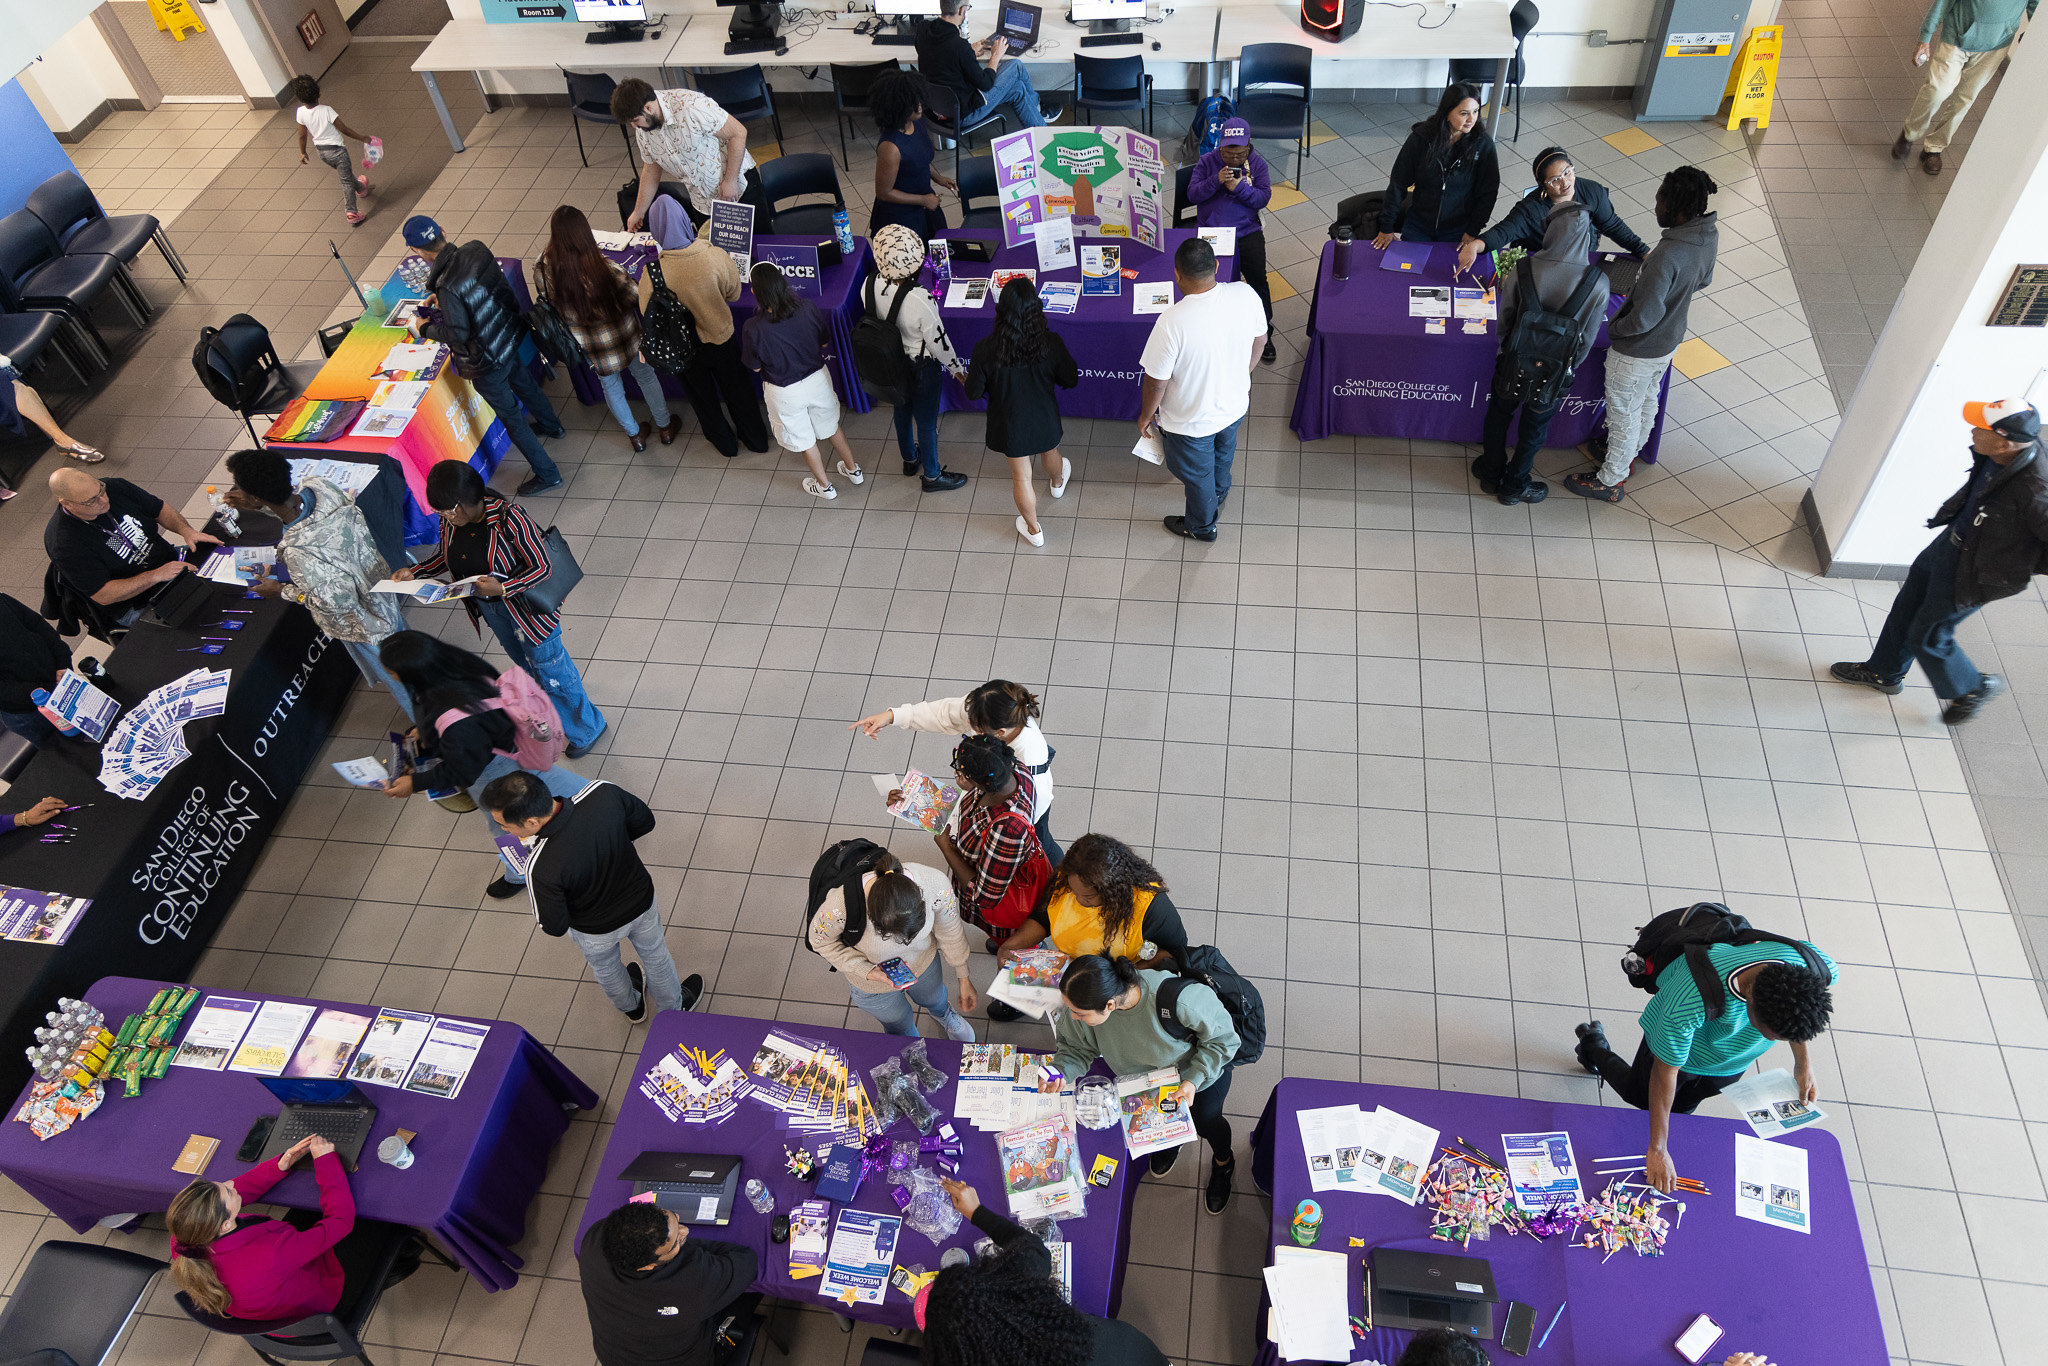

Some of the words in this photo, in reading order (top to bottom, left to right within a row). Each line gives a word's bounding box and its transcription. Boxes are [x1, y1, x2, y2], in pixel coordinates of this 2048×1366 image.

[542, 8, 555, 16] 123
[302, 12, 323, 46] EXIT
[1753, 52, 1774, 61] CAUTION
[1224, 128, 1245, 137] SDCCE
[734, 225, 749, 233] REACH
[1101, 226, 1127, 237] Community
[729, 232, 743, 240] GOAL!
[777, 265, 815, 278] DCCE
[1077, 369, 1134, 380] ORWARD
[1345, 378, 1365, 388] SAN
[1366, 379, 1395, 389] DIEGO
[1397, 380, 1436, 391] COLLEGE
[1438, 384, 1450, 392] OF
[1332, 385, 1398, 399] CONTINUING
[1400, 388, 1462, 402] EDUCATION
[254, 629, 335, 758] OUTREACH
[132, 845, 168, 891] SAN
[161, 786, 206, 848] DIEGO
[153, 828, 200, 892] COLLEGE
[196, 803, 211, 827] OF
[138, 780, 250, 945] CONTINUING
[168, 806, 260, 940] EDUCATION
[774, 1093, 788, 1102] FREE
[832, 1272, 850, 1282] WEEK
[851, 1276, 880, 1285] WELCOME
